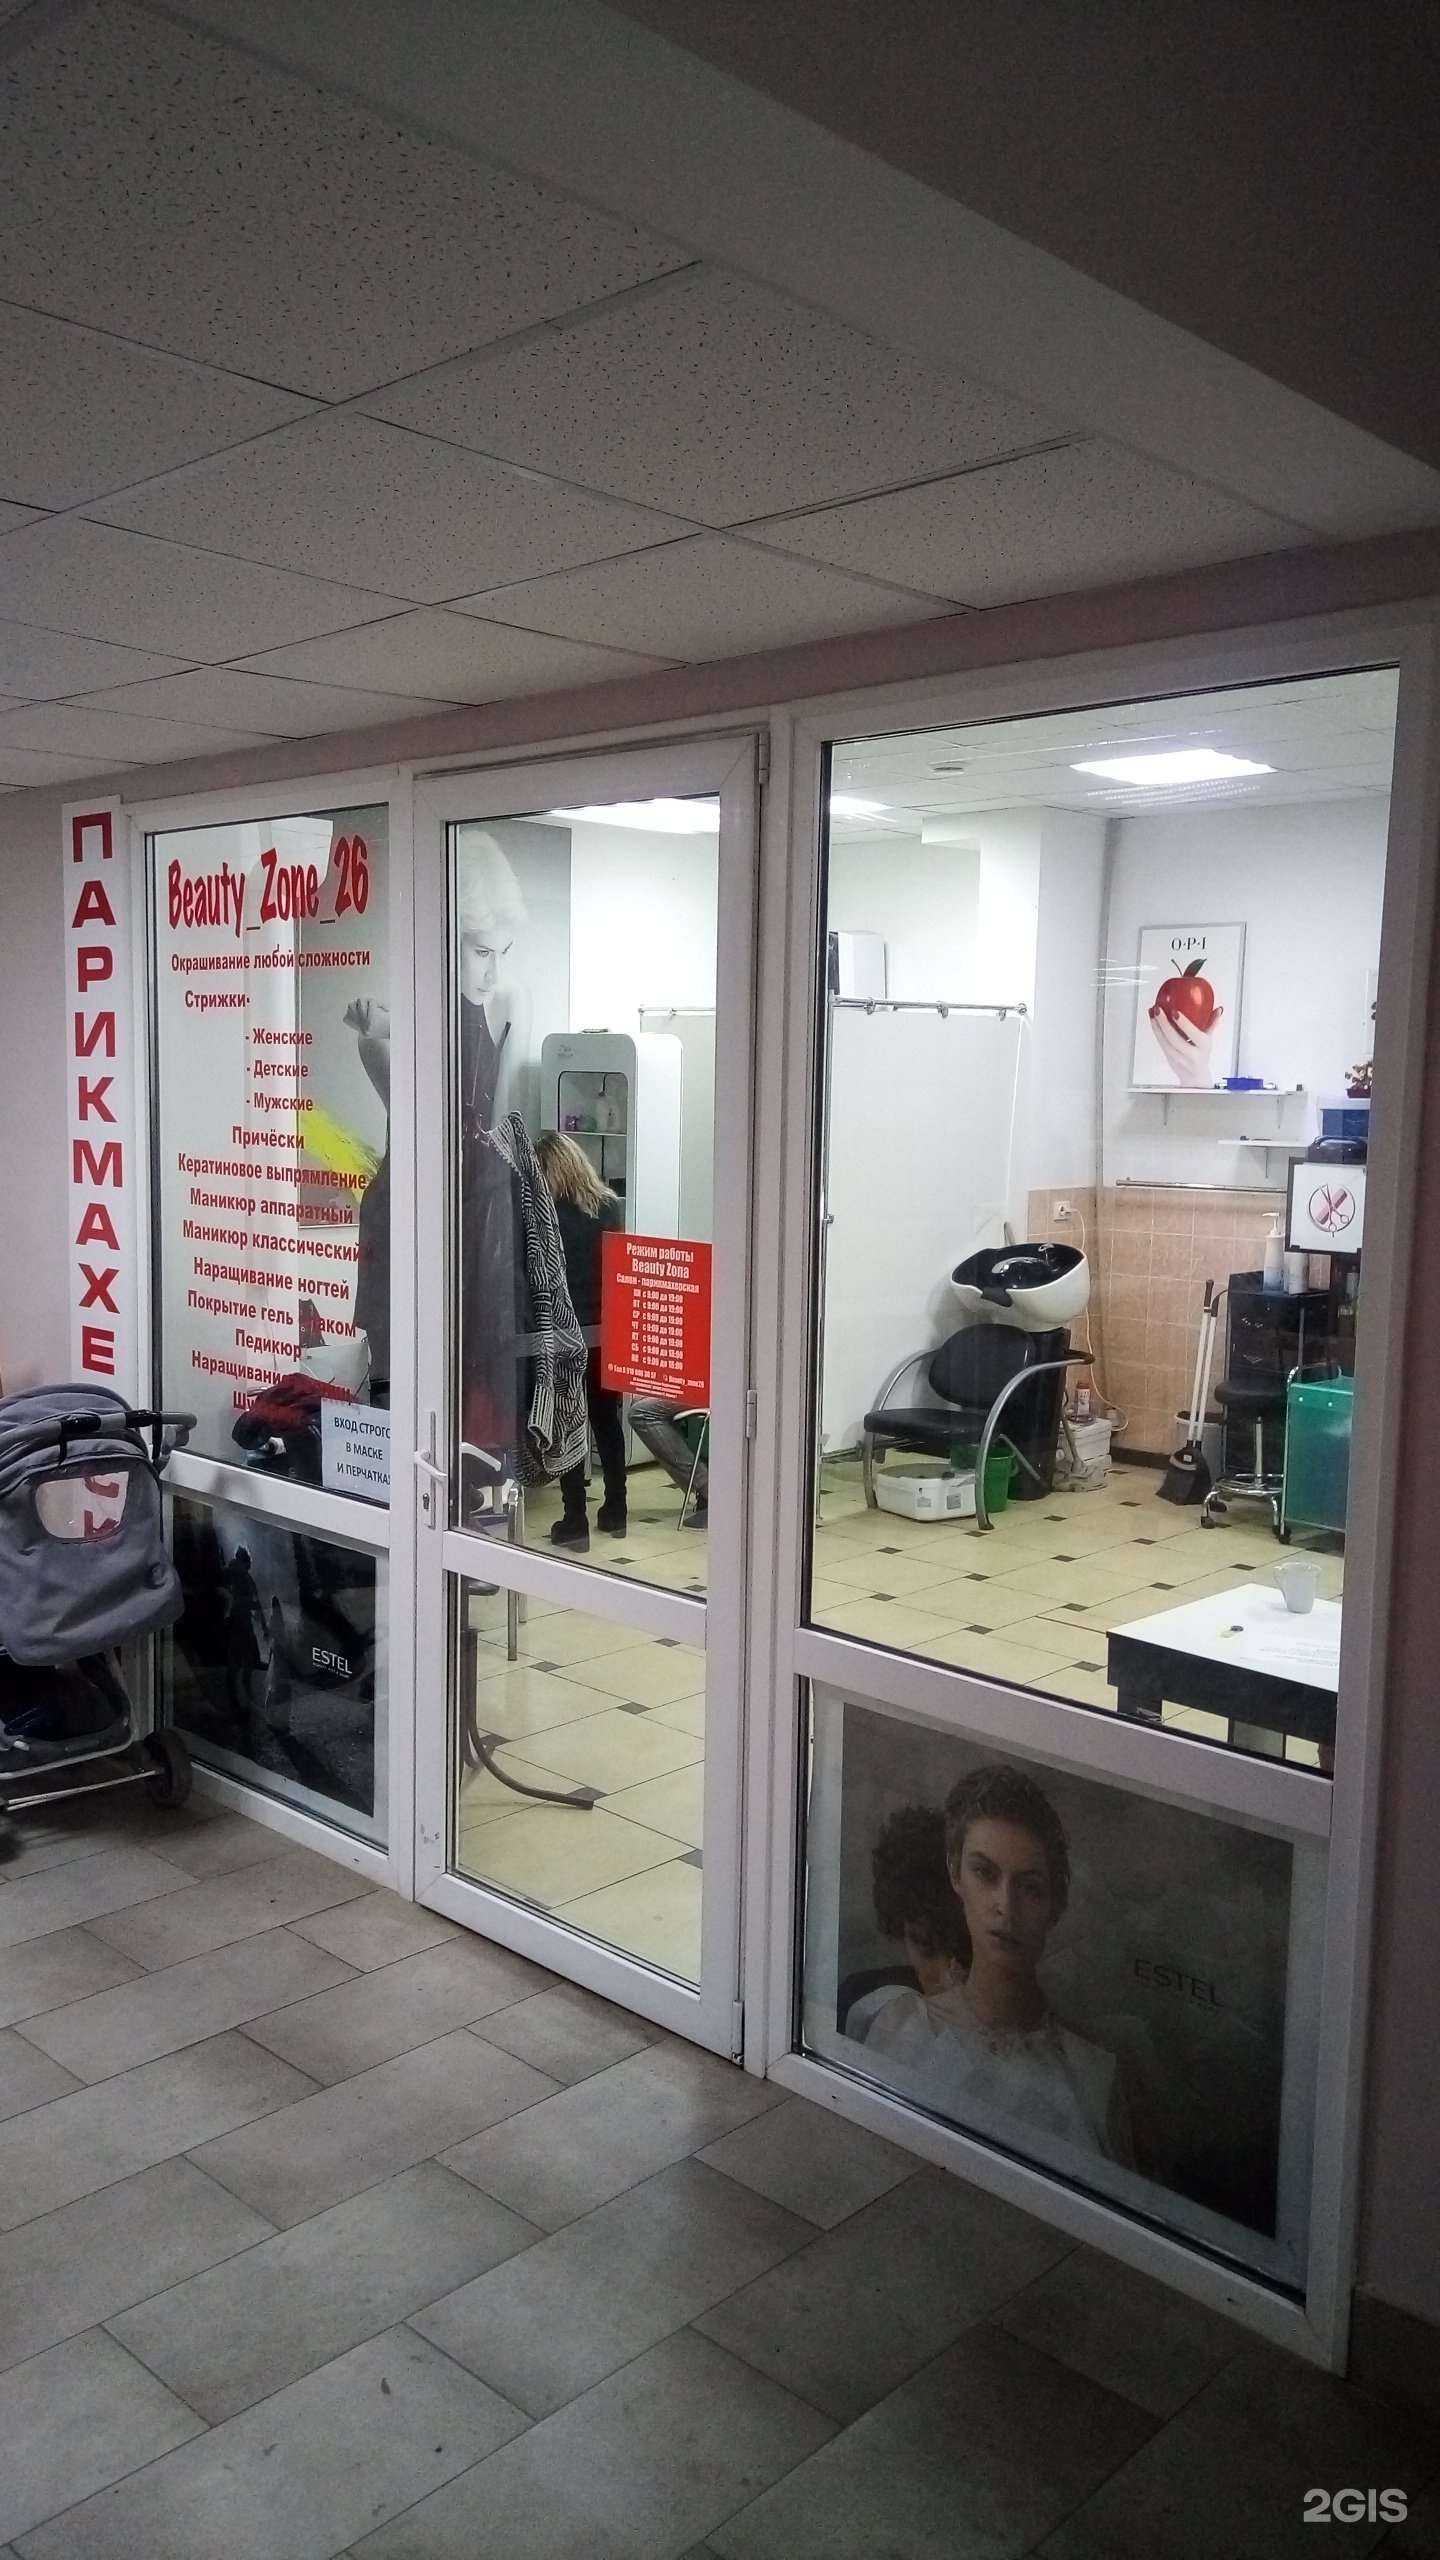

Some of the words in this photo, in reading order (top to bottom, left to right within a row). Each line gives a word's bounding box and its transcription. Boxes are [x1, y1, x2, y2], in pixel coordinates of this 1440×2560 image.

[171, 953, 250, 975] Окрашивание
[254, 944, 294, 968] любой
[298, 950, 370, 968] сложности
[253, 1027, 313, 1046] Женские
[253, 1059, 309, 1078] Детские
[253, 1092, 313, 1112] Мужские
[232, 1126, 305, 1150] Причёски
[178, 1152, 262, 1180] Кератиновое
[266, 1165, 366, 1190] выпрямление
[190, 1187, 256, 1216] Маникюр
[260, 1199, 353, 1224] аппаратный
[183, 1220, 248, 1250] Маникюр
[252, 1233, 361, 1262] классический
[626, 1242, 658, 1258] Режим
[658, 1247, 694, 1263] работы
[193, 1257, 293, 1291] Наращивание
[298, 1277, 350, 1300] ногтей
[632, 1258, 666, 1277] Beauty
[666, 1262, 690, 1279] Zona
[187, 1290, 257, 1319] Покрытие
[261, 1307, 294, 1326] гель
[313, 1316, 357, 1338] аком
[235, 1328, 302, 1362] Педикюр
[334, 1417, 358, 1434] ВХОД
[346, 1442, 352, 1453] В
[353, 1443, 383, 1460] МАСКЕ
[337, 1462, 344, 1473] И
[312, 1647, 353, 1674] ESTEL
[1133, 1957, 1226, 2008] ESTEL
